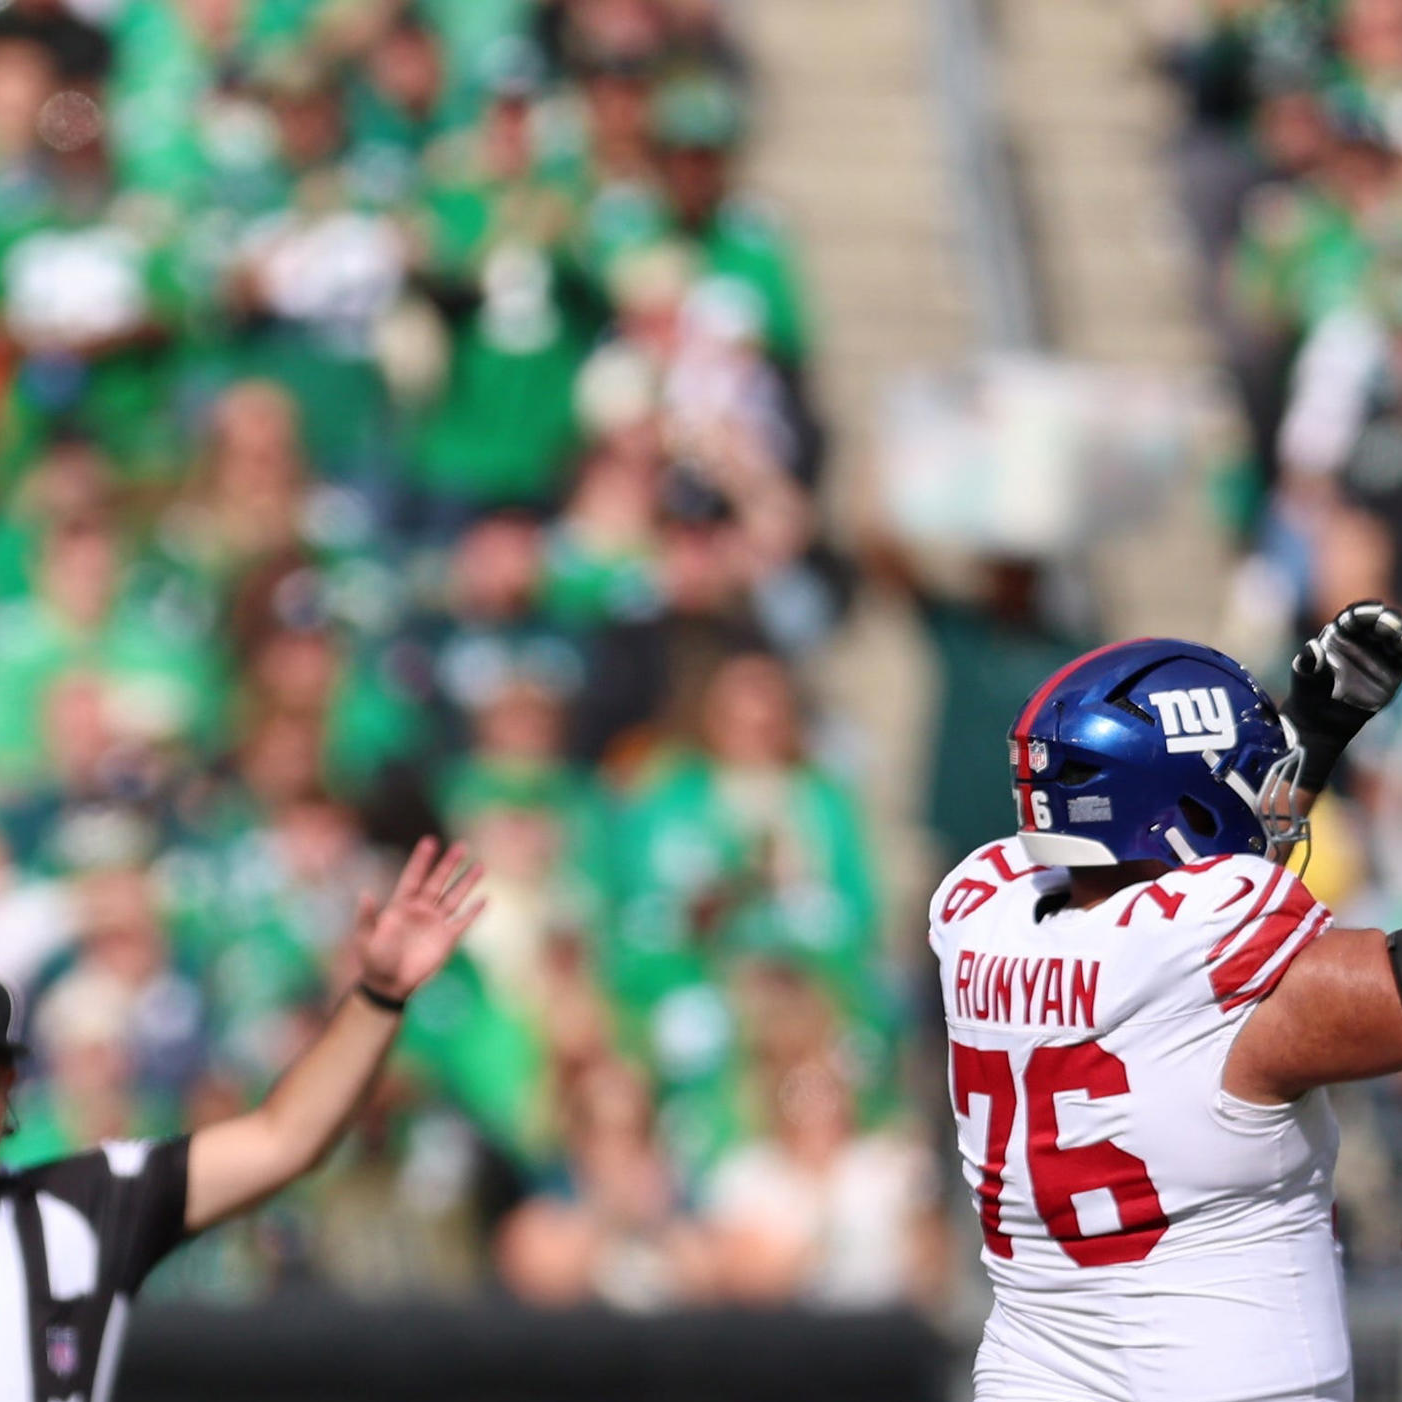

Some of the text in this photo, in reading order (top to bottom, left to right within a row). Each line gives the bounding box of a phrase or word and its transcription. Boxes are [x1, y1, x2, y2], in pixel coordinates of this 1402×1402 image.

[1148, 687, 1236, 753] ny
[955, 950, 1100, 1028] RUNYAN
[950, 1040, 1169, 1268] 76
